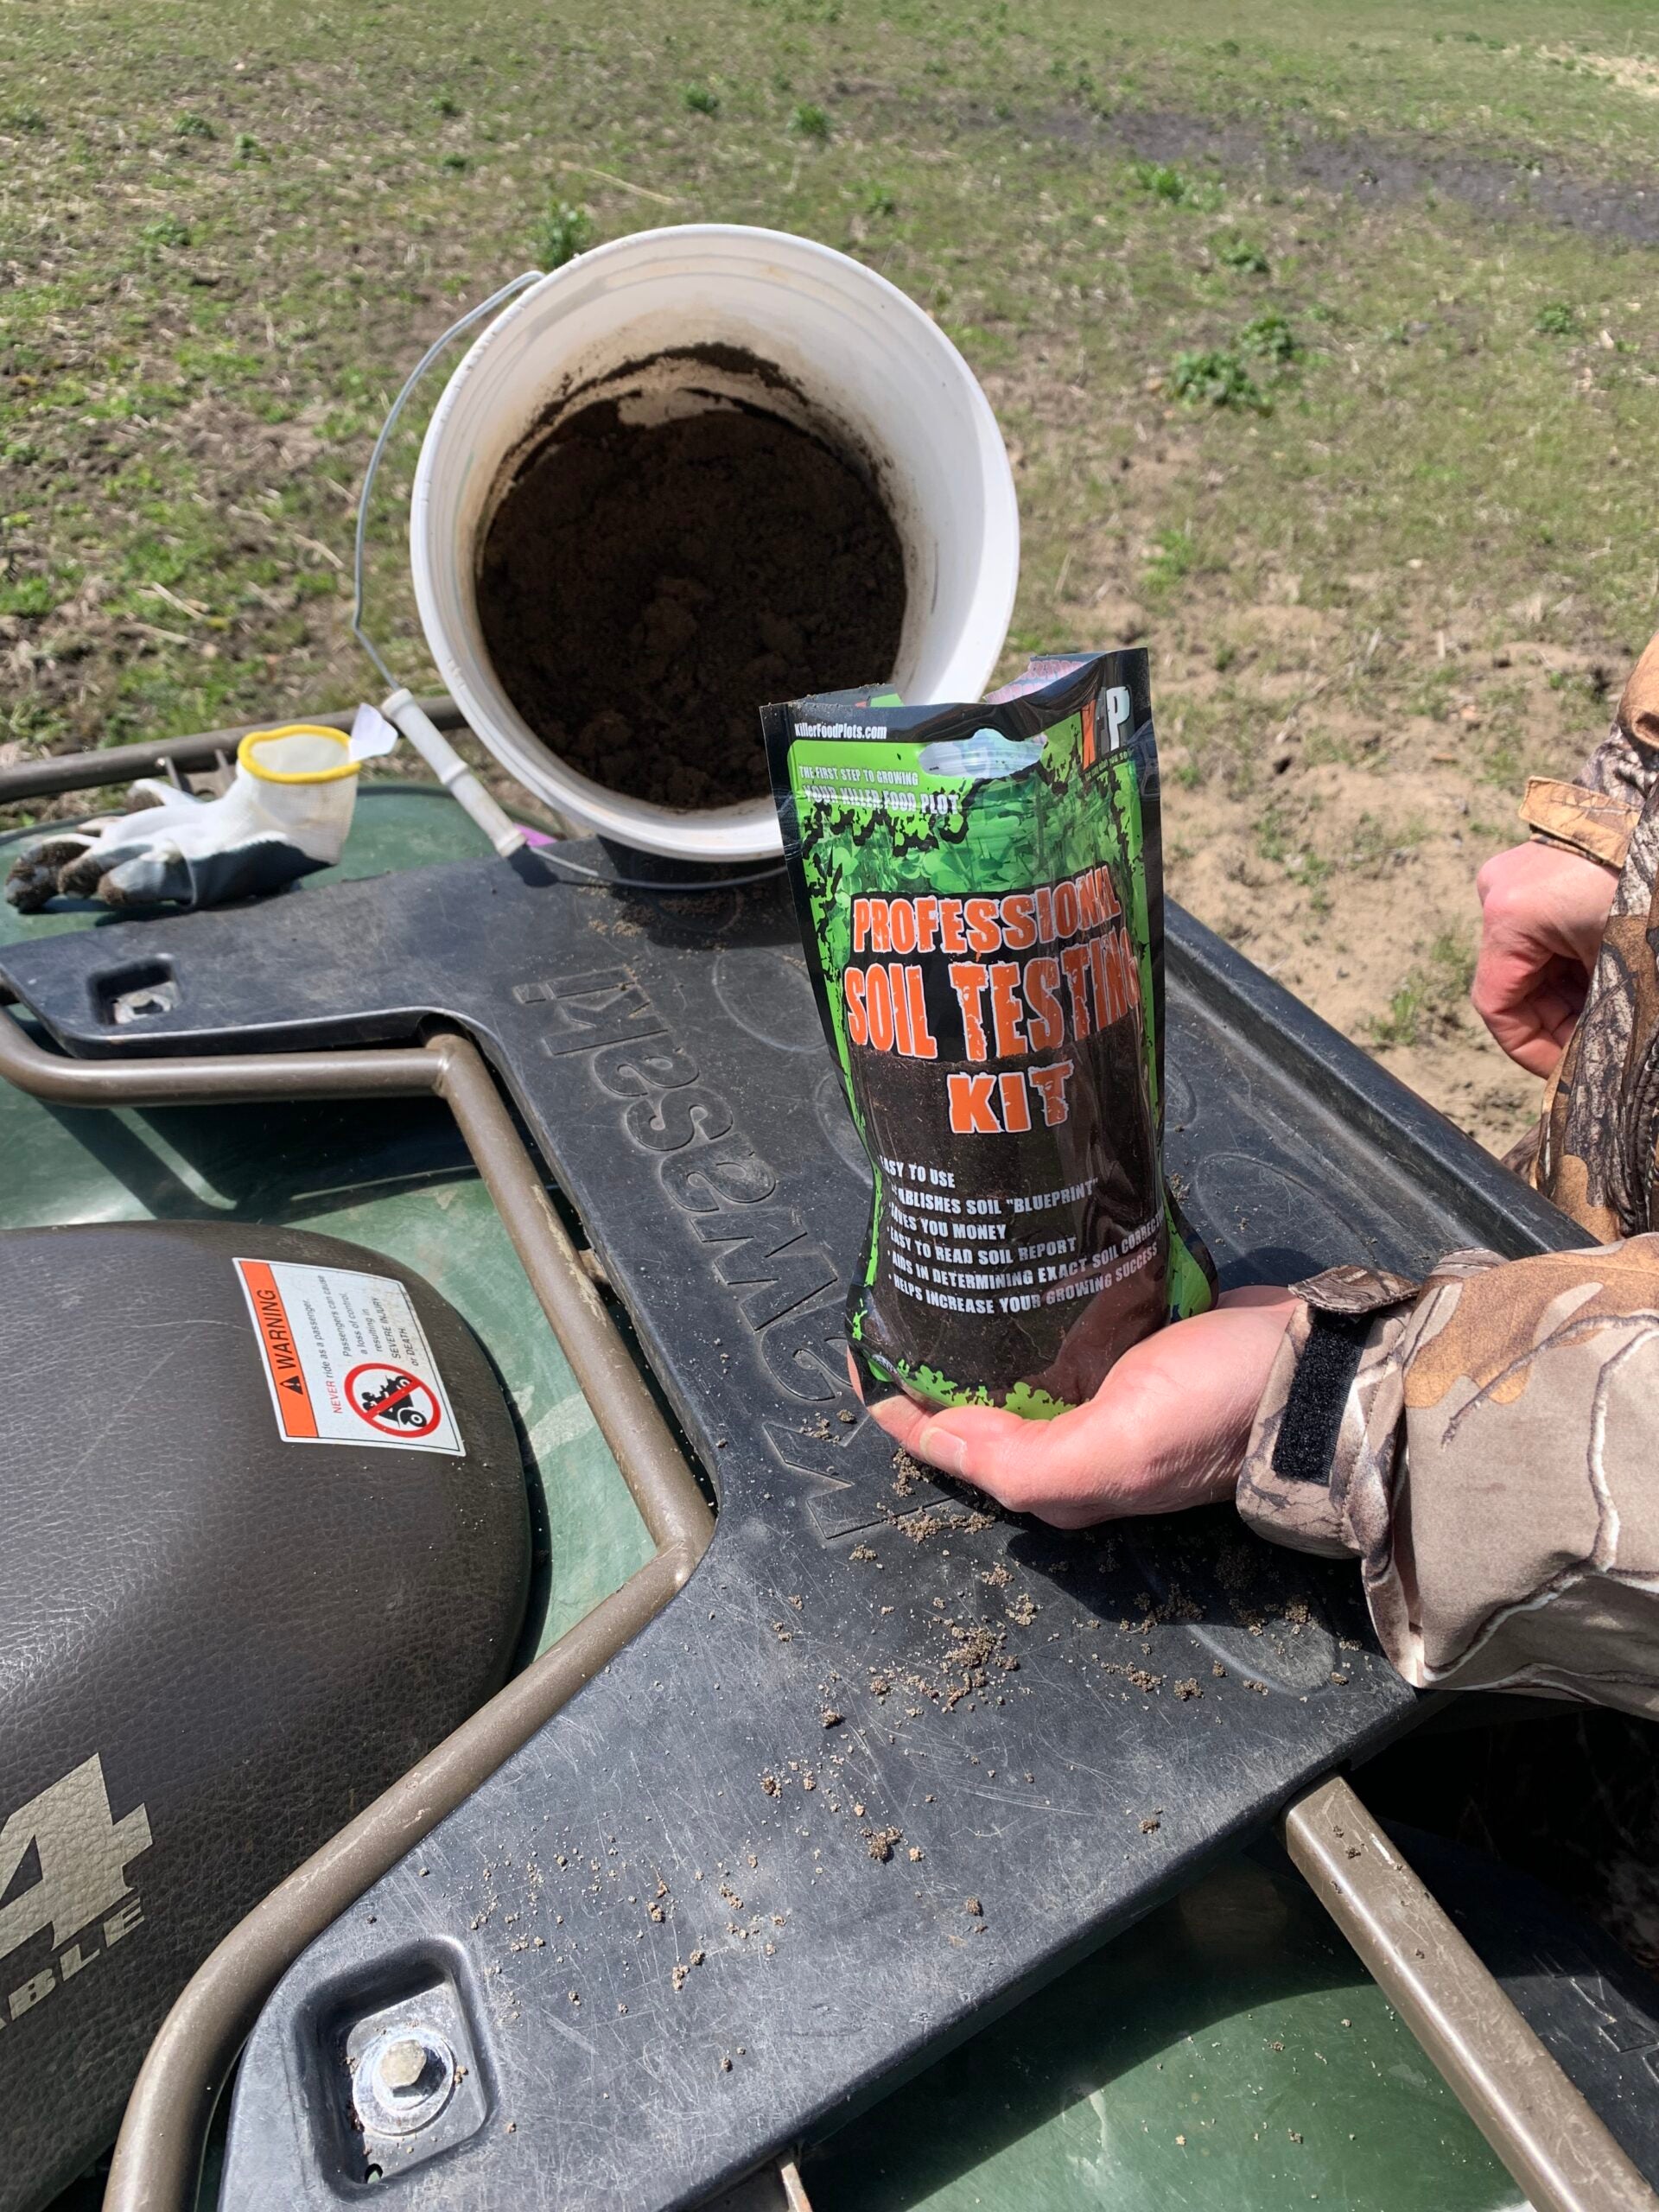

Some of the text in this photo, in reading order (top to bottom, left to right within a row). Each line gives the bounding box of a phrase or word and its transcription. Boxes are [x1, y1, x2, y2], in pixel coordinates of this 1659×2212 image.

[794, 722, 887, 740] KillerFoodPlots.com
[798, 766, 918, 786] THE FIRST STEP TO GROWING
[803, 785, 959, 815] YOUR KILLER FOOD PLOT
[853, 865, 1122, 954] PROFESSIONAL
[844, 927, 1140, 1061] SOIL TESTING
[947, 1058, 1074, 1134] KIT
[908, 1164, 926, 1182] TO
[929, 1168, 956, 1189] USE
[966, 1199, 1002, 1215] SOIL
[1006, 1177, 1098, 1213] "BLUEPRINT"
[890, 1225, 1077, 1265] EASY TO READ SOIL REPORT
[920, 1217, 948, 1237] YOU
[952, 1223, 1007, 1240] MONEY
[892, 1251, 913, 1275] AIDS
[915, 1263, 929, 1281] IN
[931, 1268, 1034, 1290] DETERMINING
[1038, 1256, 1088, 1283] EXACT
[1092, 1245, 1119, 1268] SOIL
[893, 1242, 1158, 1314] HELPS INCREASE YOUR GROWING SUCCESS
[257, 1289, 296, 1370] WARNING
[302, 1300, 325, 1340] passenger.
[318, 1275, 353, 1357] Passengers can cause
[348, 1320, 359, 1329] of
[365, 1317, 383, 1352] resulting
[372, 1297, 401, 1359] SEVERE INJURY
[318, 1349, 329, 1360] as
[354, 1331, 365, 1348] loss
[321, 1362, 334, 1378] ride
[326, 1381, 342, 1414] NEVER
[0, 1897, 145, 2031] BLE
